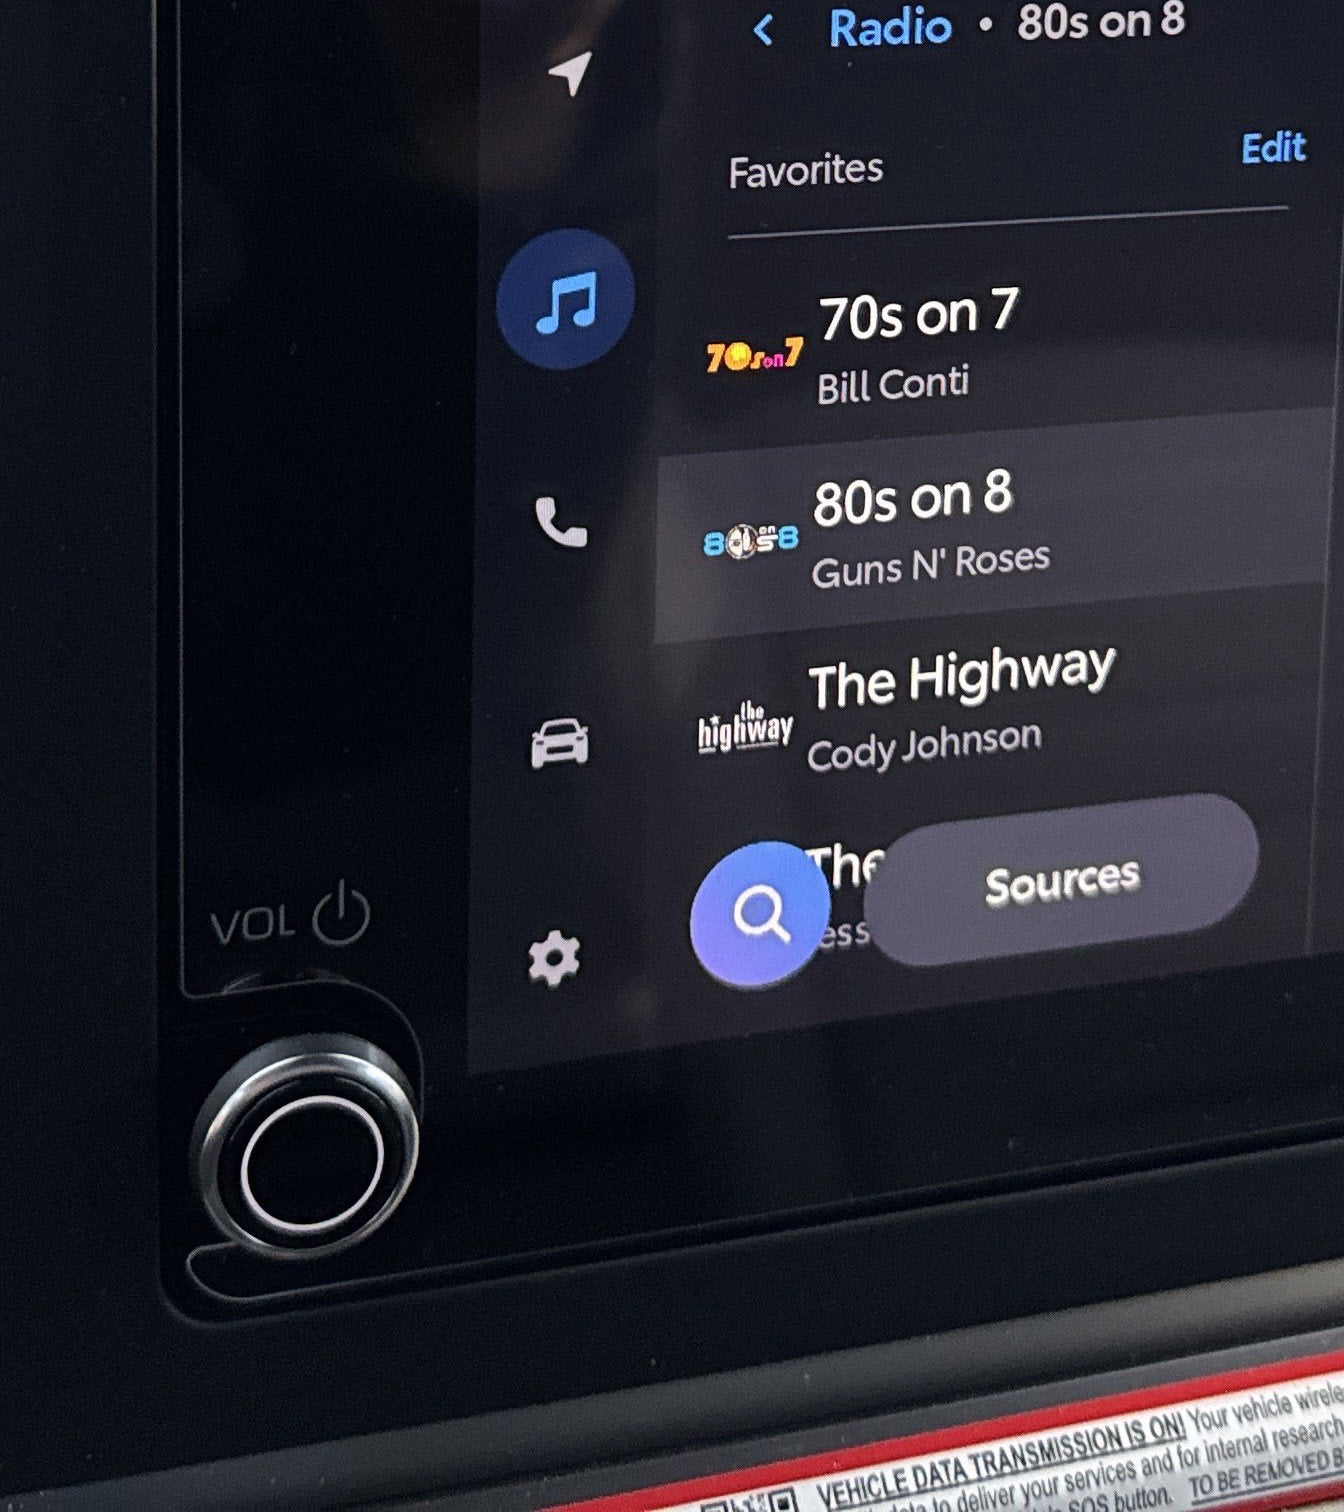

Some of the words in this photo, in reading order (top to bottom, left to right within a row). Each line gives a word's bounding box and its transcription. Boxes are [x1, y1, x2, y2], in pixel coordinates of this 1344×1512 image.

[830, 6, 953, 48] Radio
[1017, 3, 1089, 41] 80s
[1101, 10, 1150, 38] on
[1161, 0, 1186, 36] 8
[729, 151, 884, 190] Favorites
[1242, 131, 1308, 164] Edit
[819, 293, 904, 341] 70s
[917, 297, 977, 335] on
[992, 287, 1020, 329] 7
[817, 367, 871, 405] Bill
[880, 364, 970, 401] Conti
[814, 478, 898, 528] 80s
[911, 482, 972, 519] on
[984, 468, 1013, 513] 8
[812, 554, 902, 591] Guns
[913, 547, 946, 581] N'
[956, 540, 1051, 577] Roses
[809, 661, 897, 711] The
[909, 643, 1117, 708] Highway
[698, 714, 795, 754] highway
[740, 699, 765, 721] the
[807, 736, 897, 775] Cody
[903, 720, 1042, 764] Johnson
[985, 857, 1141, 908] Sources
[210, 903, 296, 946] VOL
[816, 1467, 909, 1509] VEHICLE
[912, 1450, 968, 1490] DATA
[968, 1424, 1123, 1479] TRANSMISSION
[1125, 1419, 1146, 1445] IS
[1186, 1405, 1230, 1434] Your
[1233, 1392, 1293, 1425] vehicle
[957, 1485, 1015, 1512] deliver
[1019, 1475, 1059, 1508] your
[1064, 1460, 1137, 1492] services
[1140, 1448, 1174, 1476] and
[1178, 1442, 1203, 1470] for
[1205, 1426, 1269, 1463] internal
[1189, 1472, 1213, 1498] TO
[1217, 1467, 1241, 1492] BE
[1244, 1450, 1331, 1486] REMOVED
